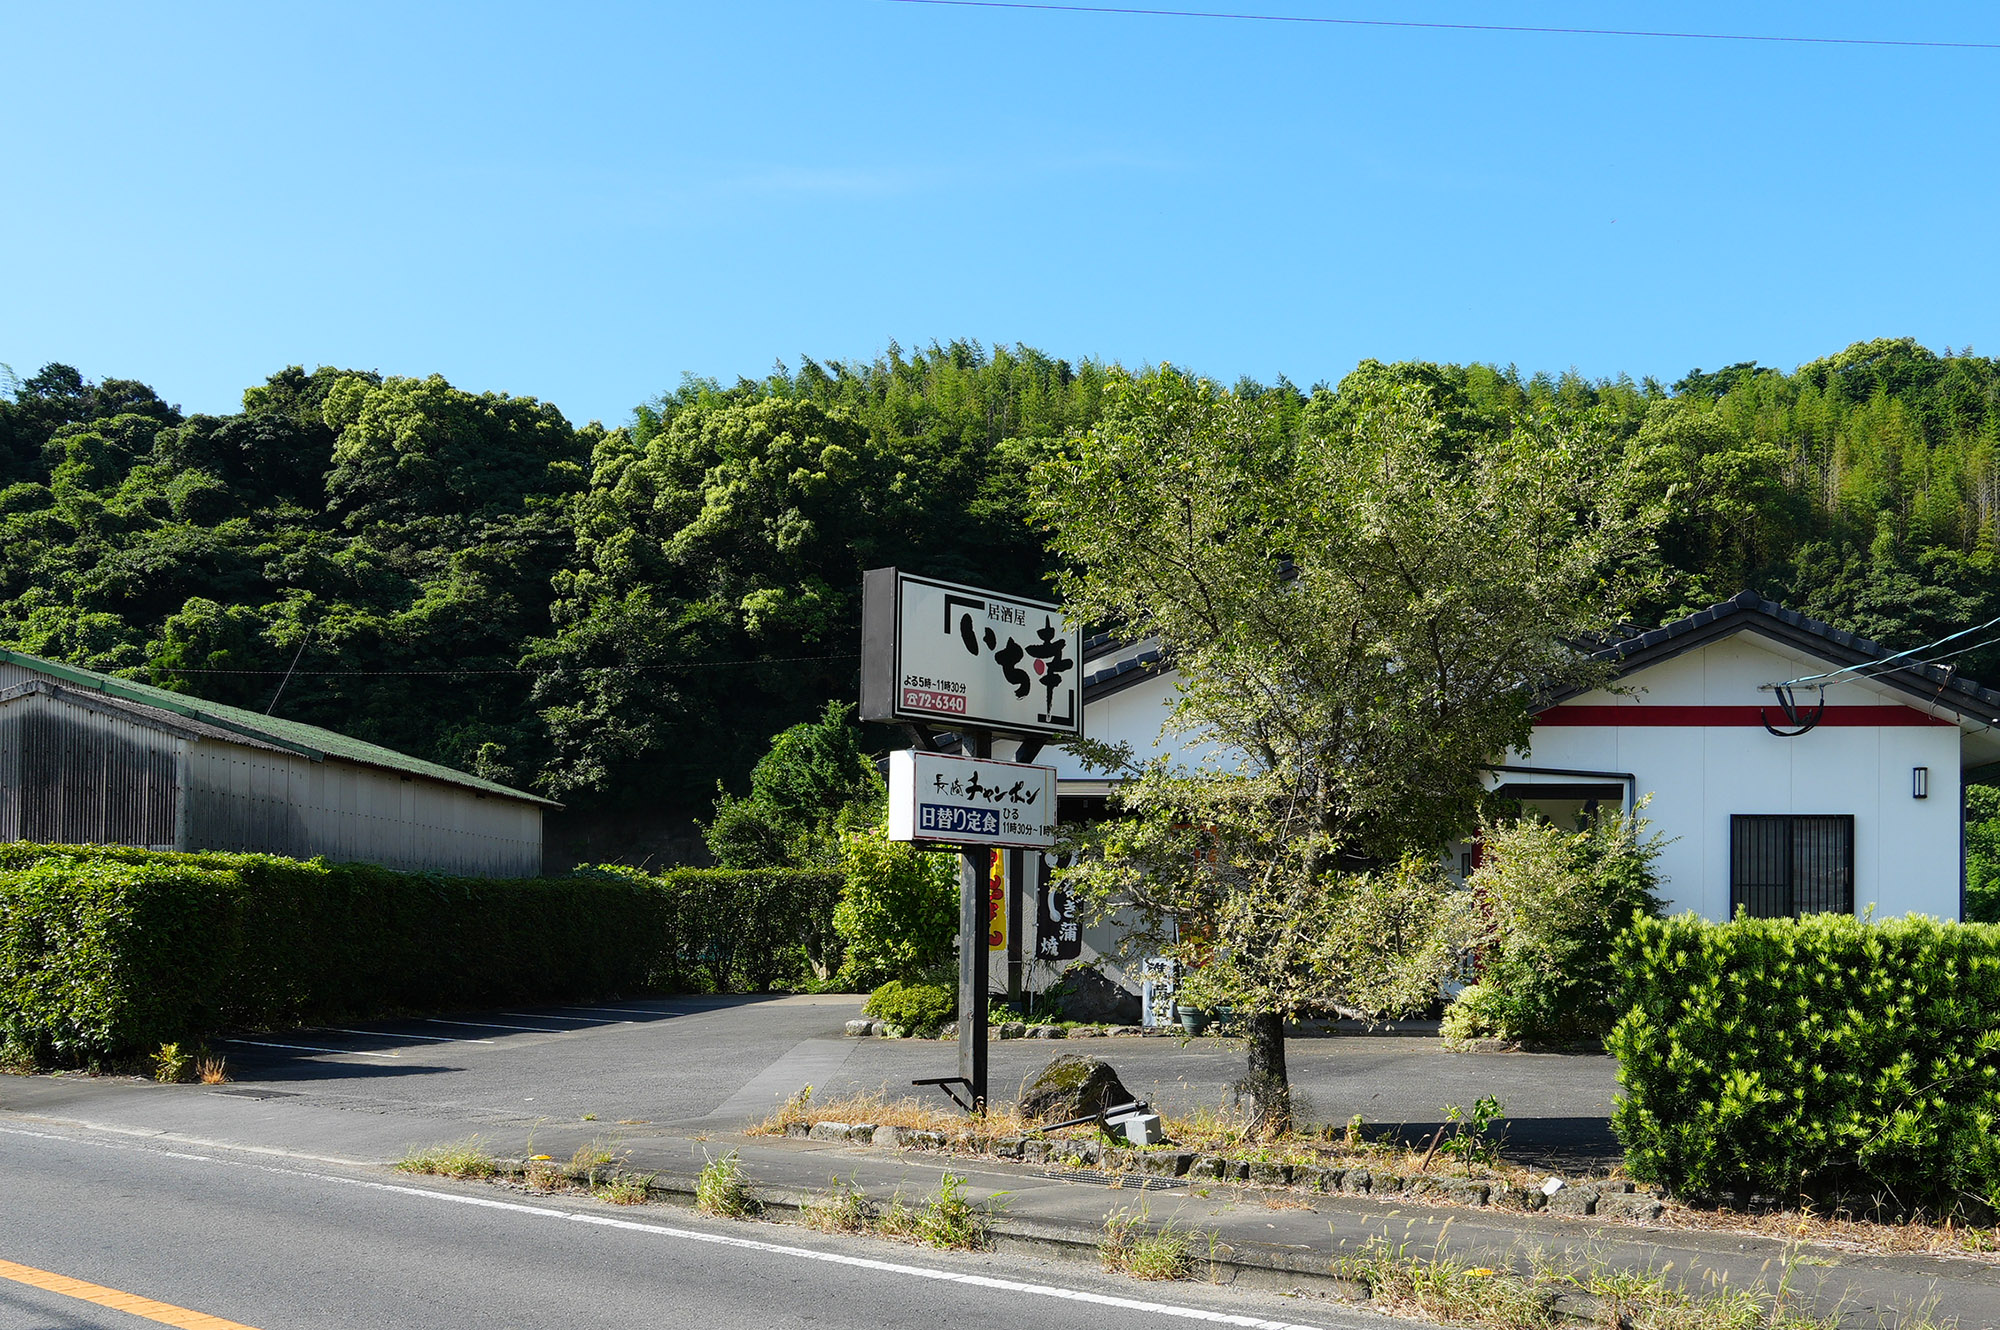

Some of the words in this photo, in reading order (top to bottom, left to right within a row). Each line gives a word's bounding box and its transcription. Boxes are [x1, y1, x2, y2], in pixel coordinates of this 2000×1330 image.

[988, 603, 1026, 627] 居酒屋
[921, 807, 998, 833] 日替り定食
[1003, 807, 1019, 820] ひる
